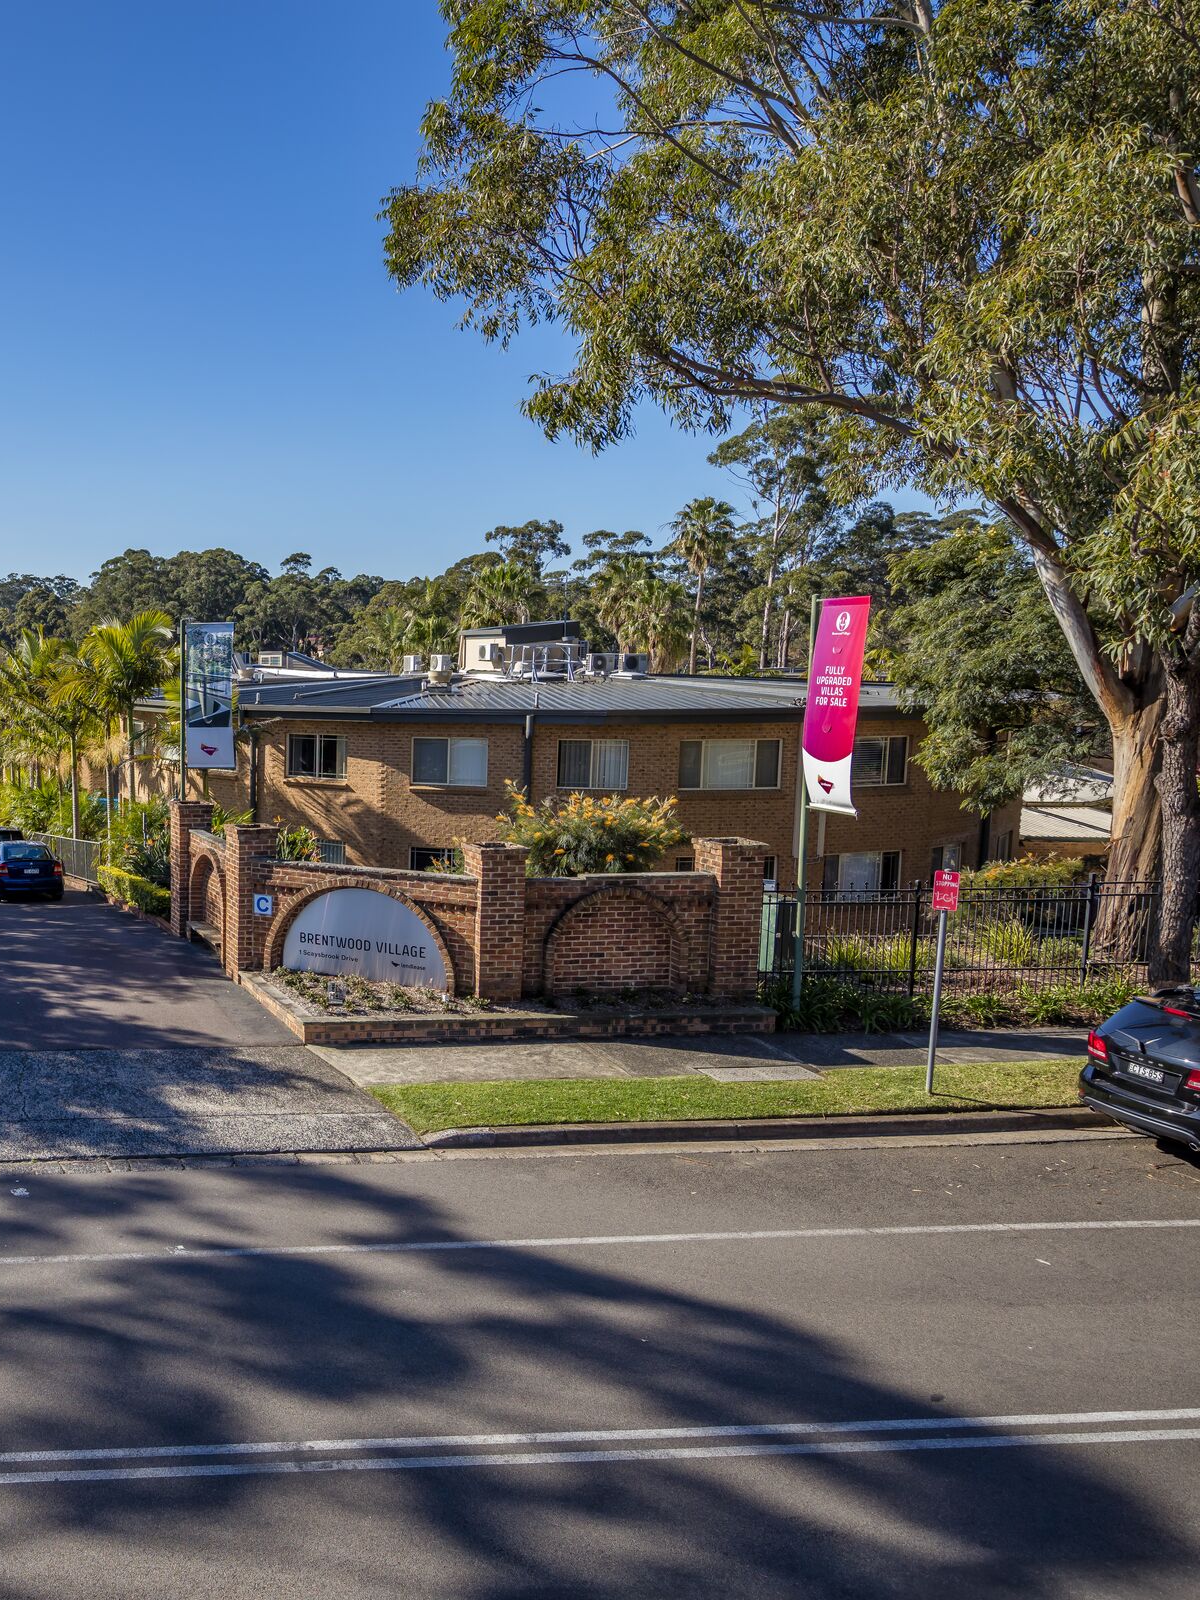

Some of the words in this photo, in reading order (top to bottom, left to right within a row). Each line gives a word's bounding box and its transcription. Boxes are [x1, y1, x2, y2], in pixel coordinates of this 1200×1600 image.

[825, 665, 845, 675] FULLY
[816, 675, 852, 686] UPGRADED
[821, 686, 844, 696] VILLAS
[815, 696, 829, 706] FOR
[830, 697, 848, 707] SALE
[257, 896, 269, 912] C
[299, 932, 371, 952] BRENTWOOD
[376, 941, 427, 959] VILLAGE
[303, 949, 340, 960] Scaysbrook
[341, 954, 359, 963] Drive
